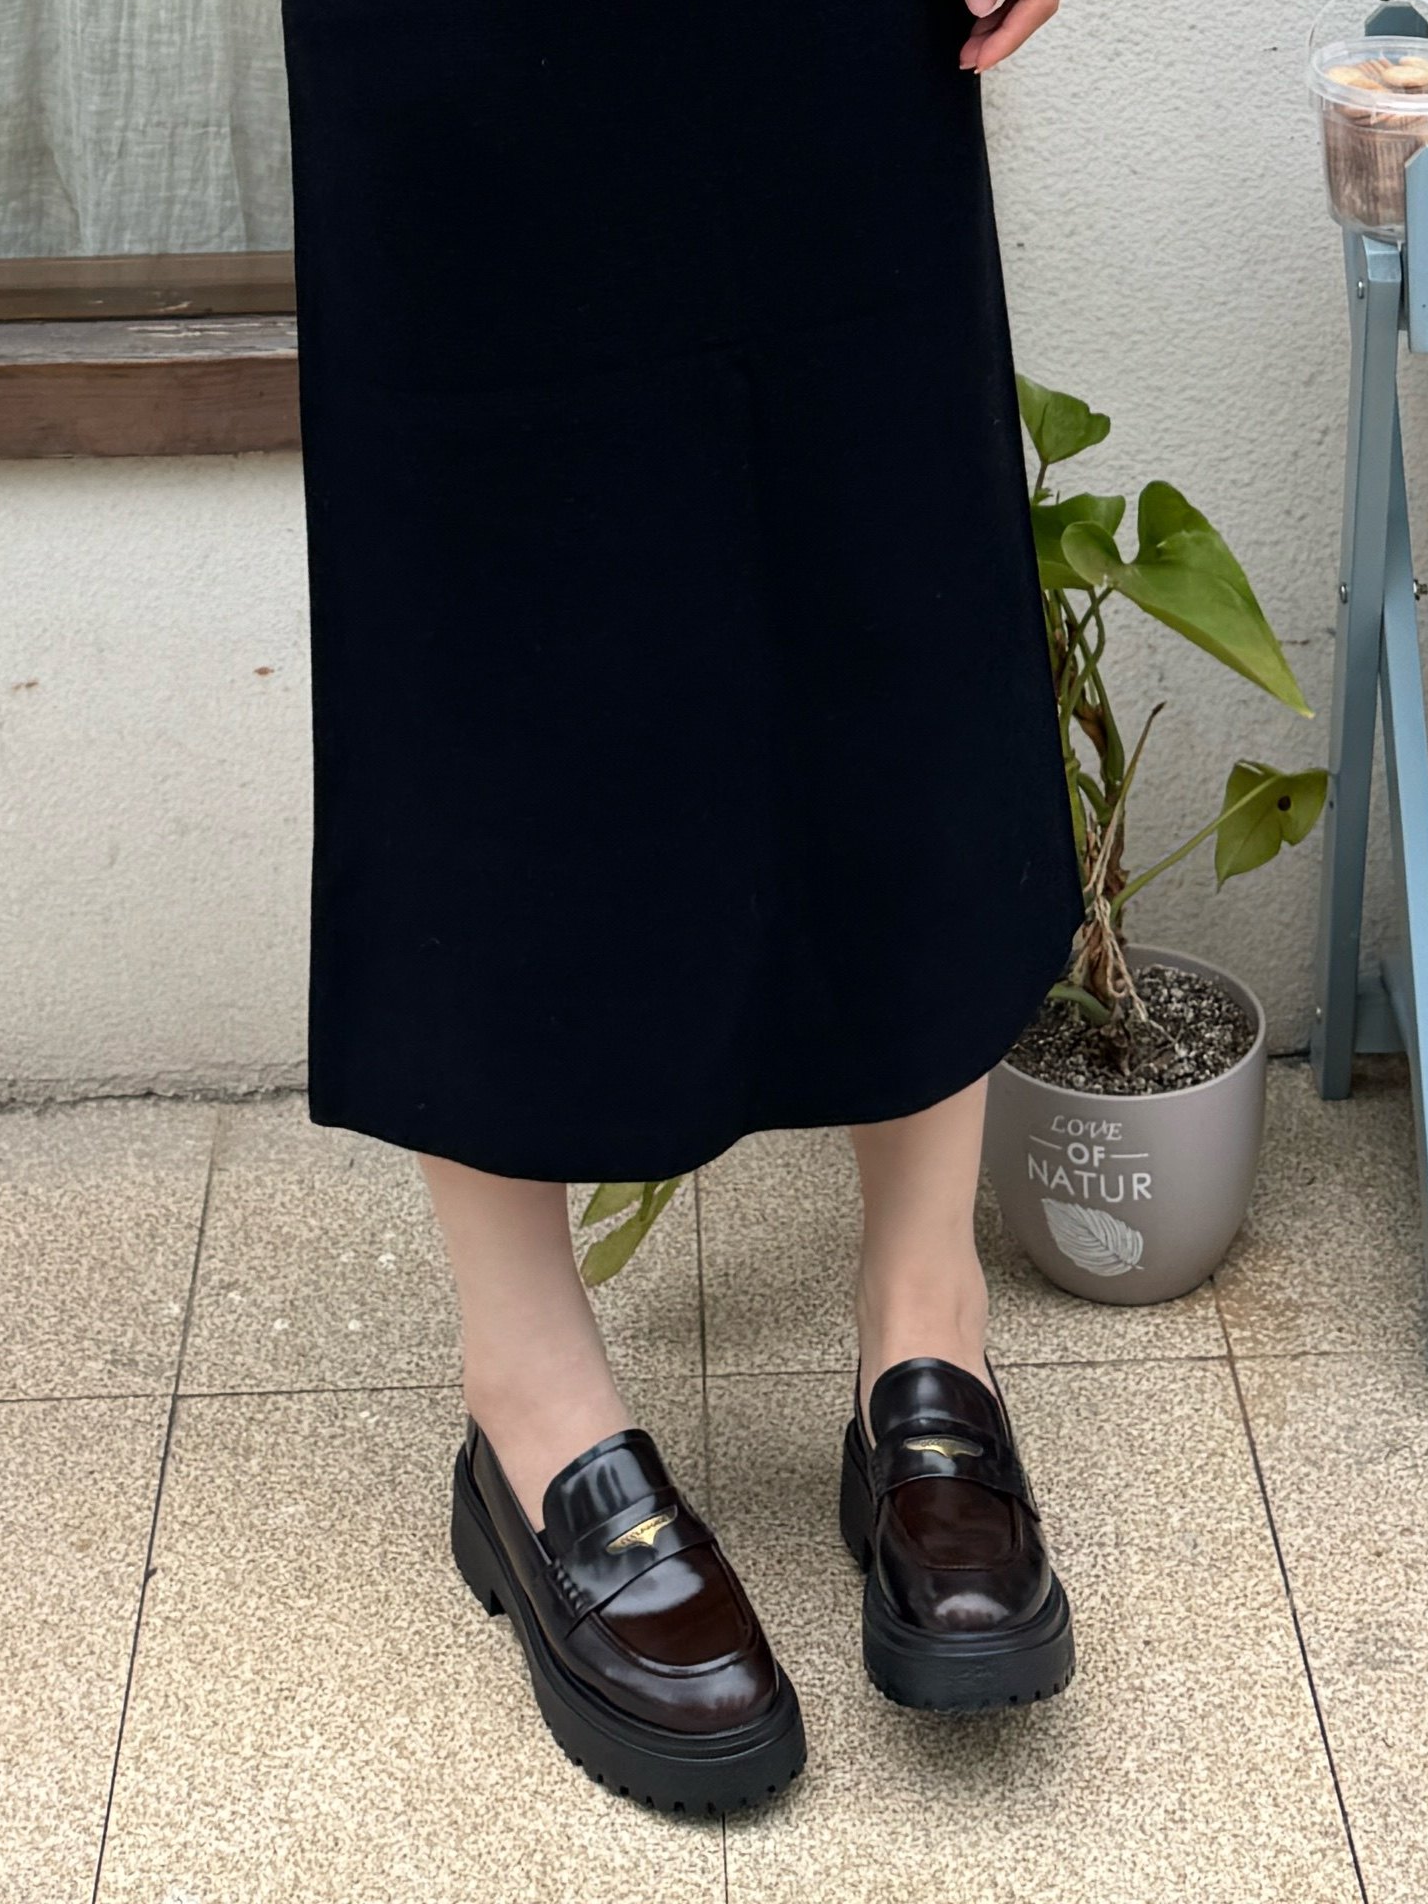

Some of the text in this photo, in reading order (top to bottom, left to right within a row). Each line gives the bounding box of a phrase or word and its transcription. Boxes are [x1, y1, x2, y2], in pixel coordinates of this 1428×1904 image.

[1050, 1114, 1123, 1141] LOVE
[1066, 1142, 1106, 1168] OF
[1027, 1152, 1152, 1203] NATUR
